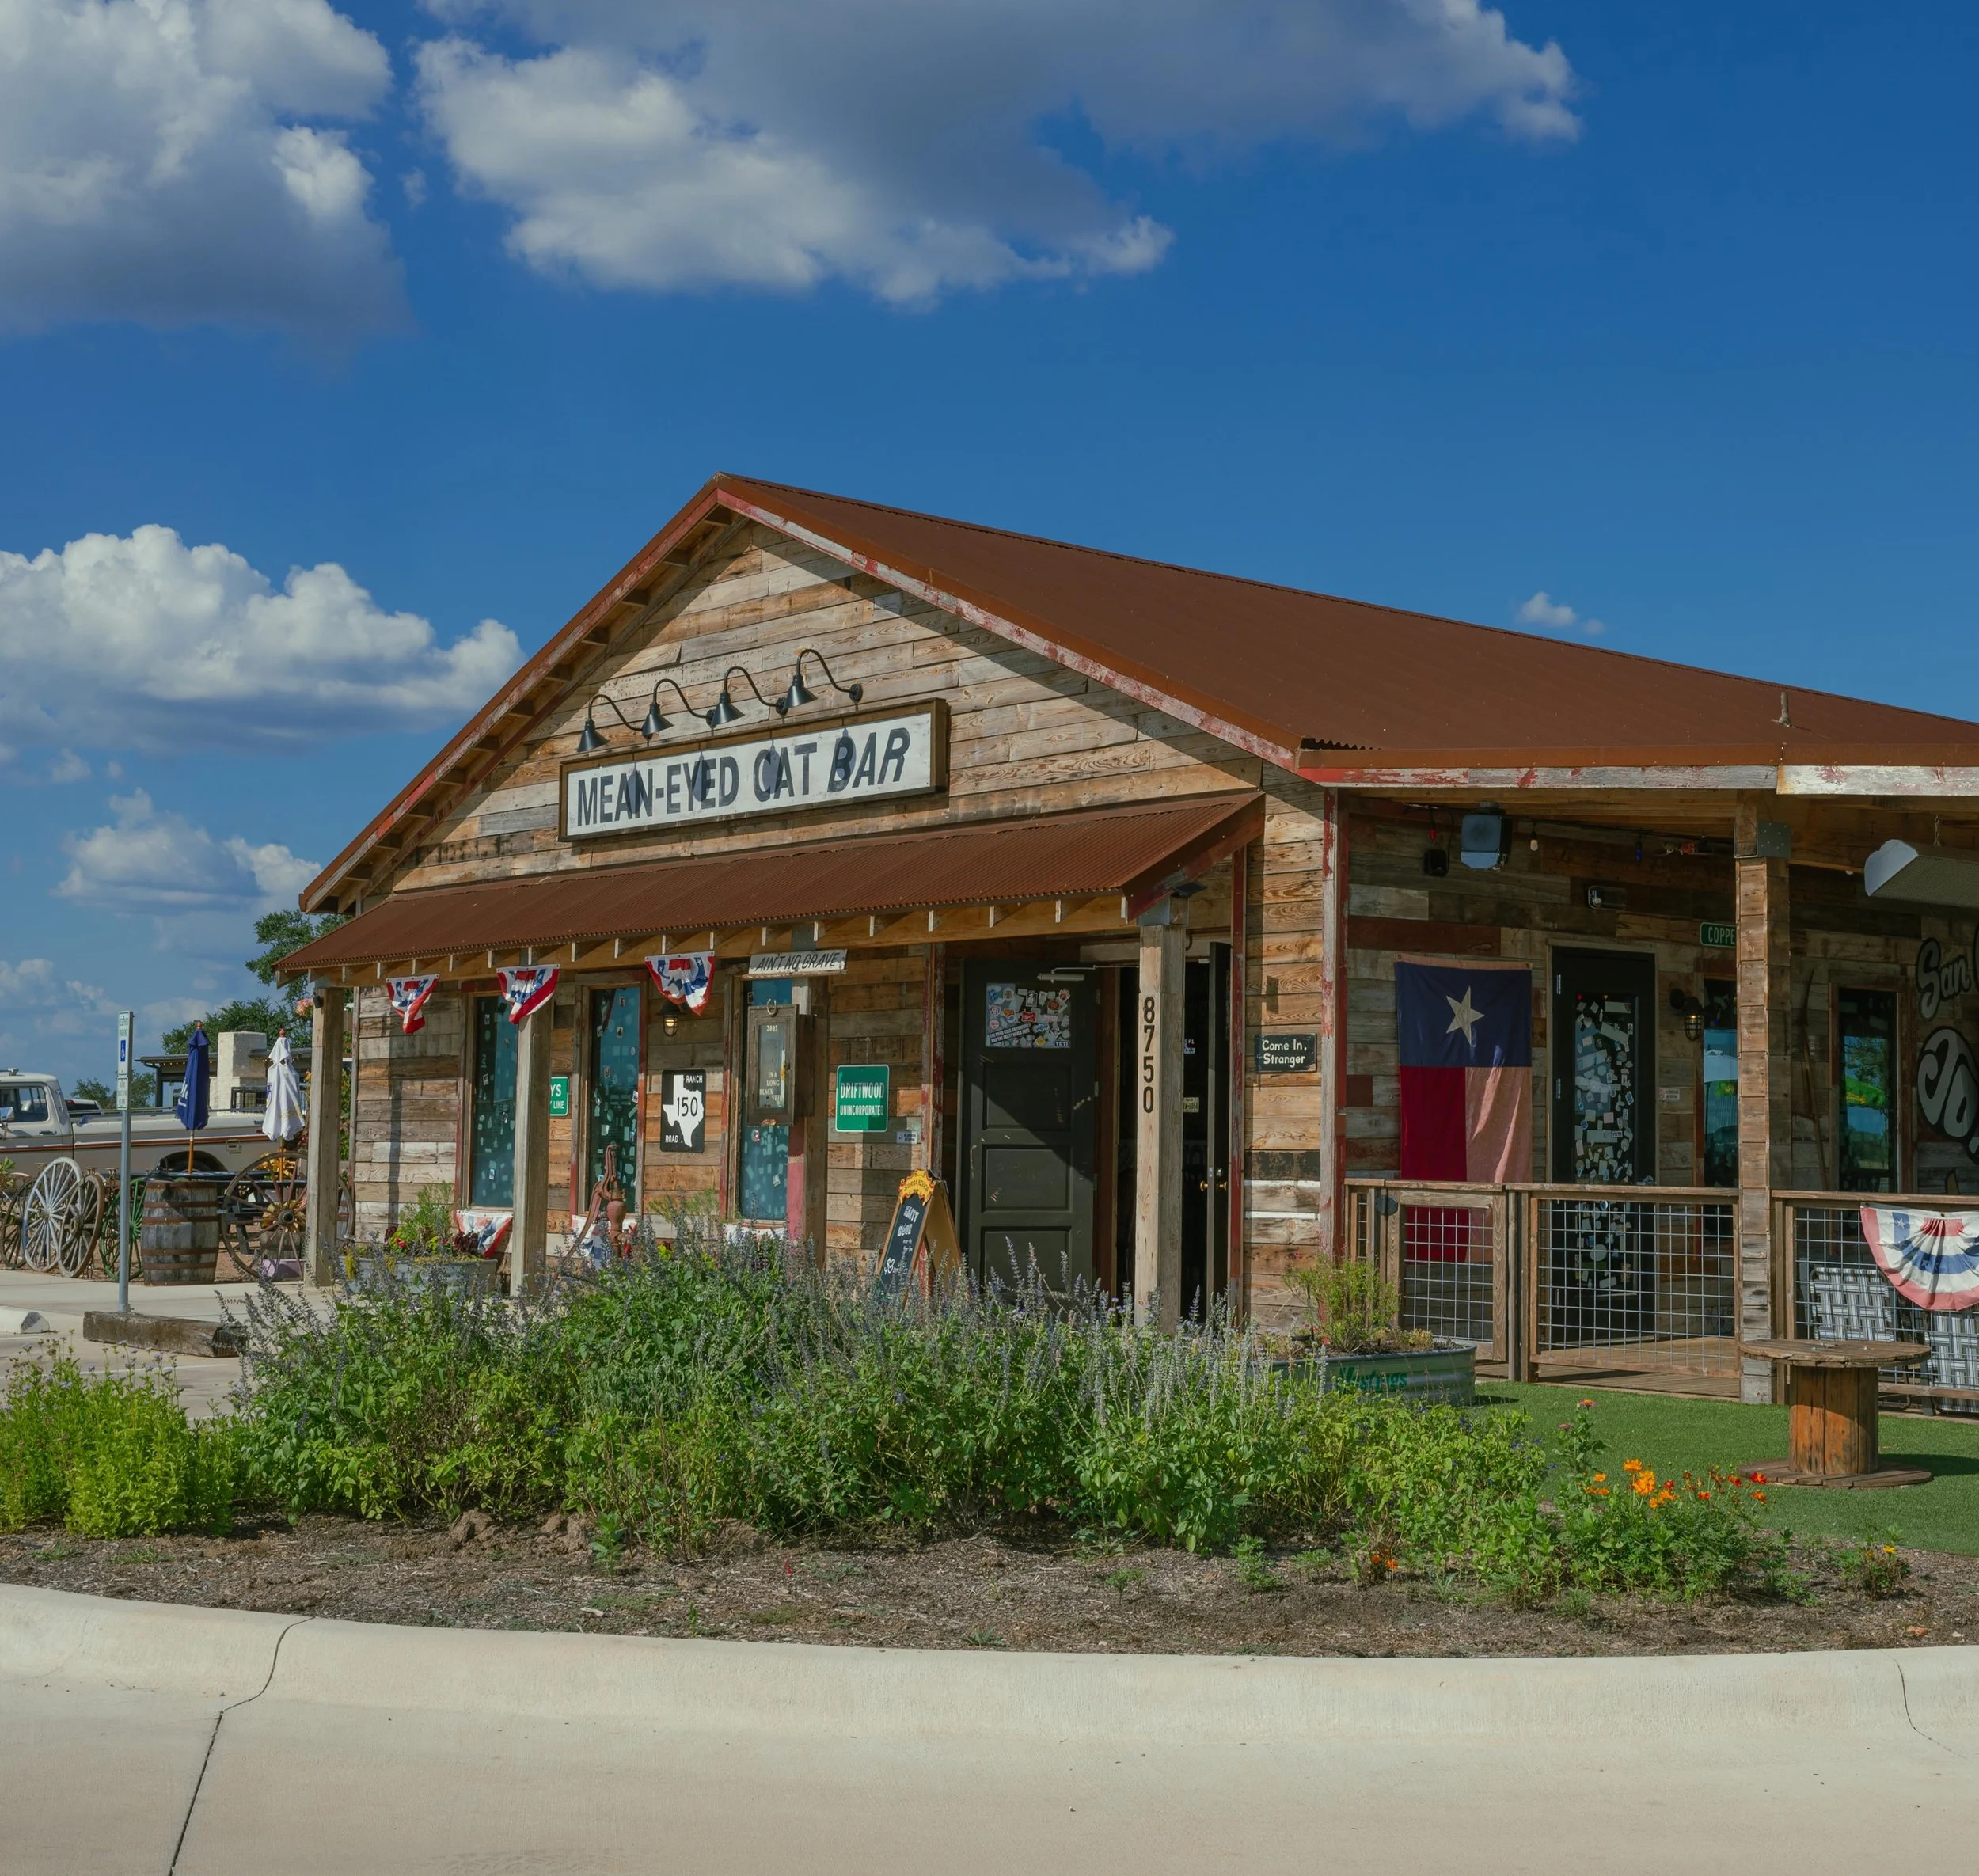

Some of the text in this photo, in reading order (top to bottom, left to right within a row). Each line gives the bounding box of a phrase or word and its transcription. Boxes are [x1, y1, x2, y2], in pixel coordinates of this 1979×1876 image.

[578, 727, 910, 827] MEAN-EYED CAT BAR
[1708, 926, 1735, 944] COPPE
[755, 953, 841, 972] AIN'T NO GRAVE
[1917, 940, 1970, 1020] San
[1262, 1039, 1307, 1051] Come In,
[1263, 1053, 1306, 1068] Stranger
[686, 1075, 703, 1084] RANCH
[550, 1084, 562, 1097] YS
[841, 1082, 884, 1099] DRIFTWOOD
[553, 1100, 564, 1109] LINE
[677, 1096, 698, 1117] 150
[840, 1105, 883, 1116] UNINCORPORATED
[665, 1134, 678, 1143] ROAD
